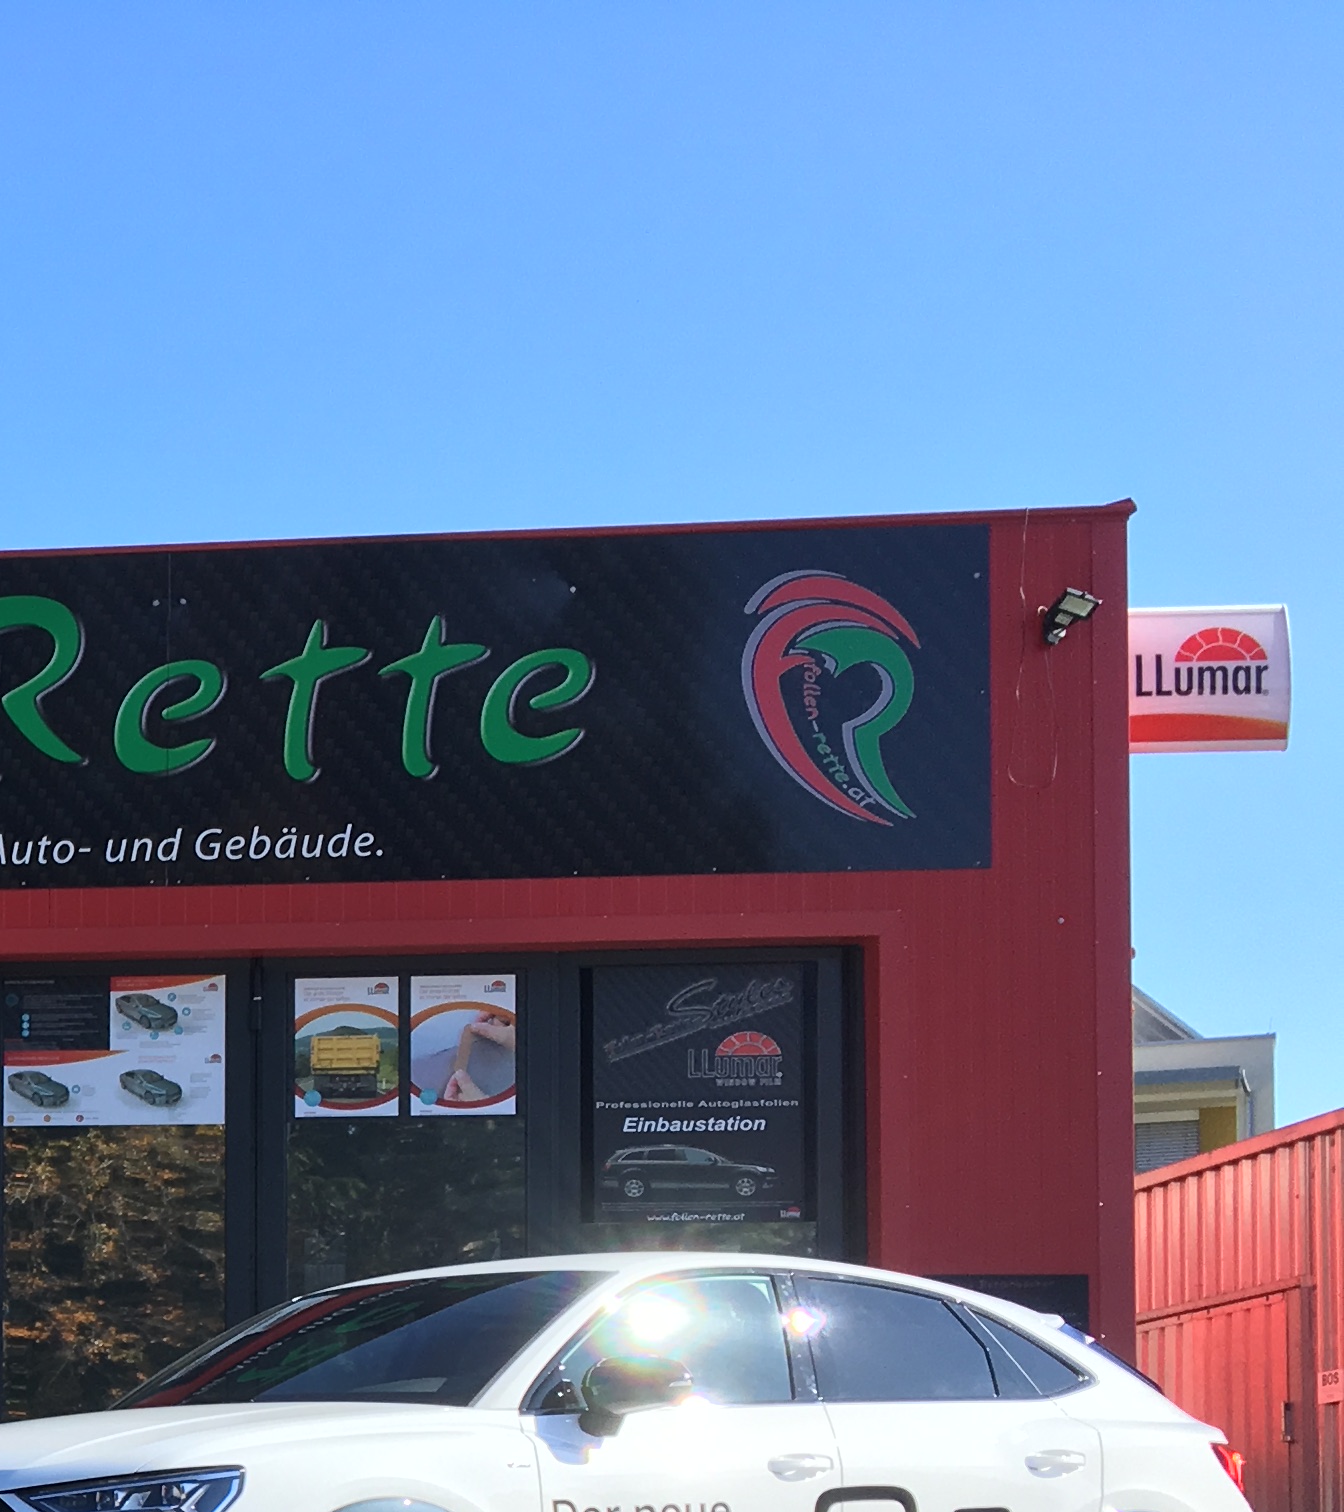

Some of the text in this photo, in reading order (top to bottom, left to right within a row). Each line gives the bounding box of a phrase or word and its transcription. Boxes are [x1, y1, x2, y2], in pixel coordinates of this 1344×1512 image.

[104, 828, 180, 863] und
[194, 823, 386, 860] Gebäude.
[596, 1098, 799, 1109] Professionelle Autoglasfolien
[622, 1116, 766, 1133] Einbaustation
